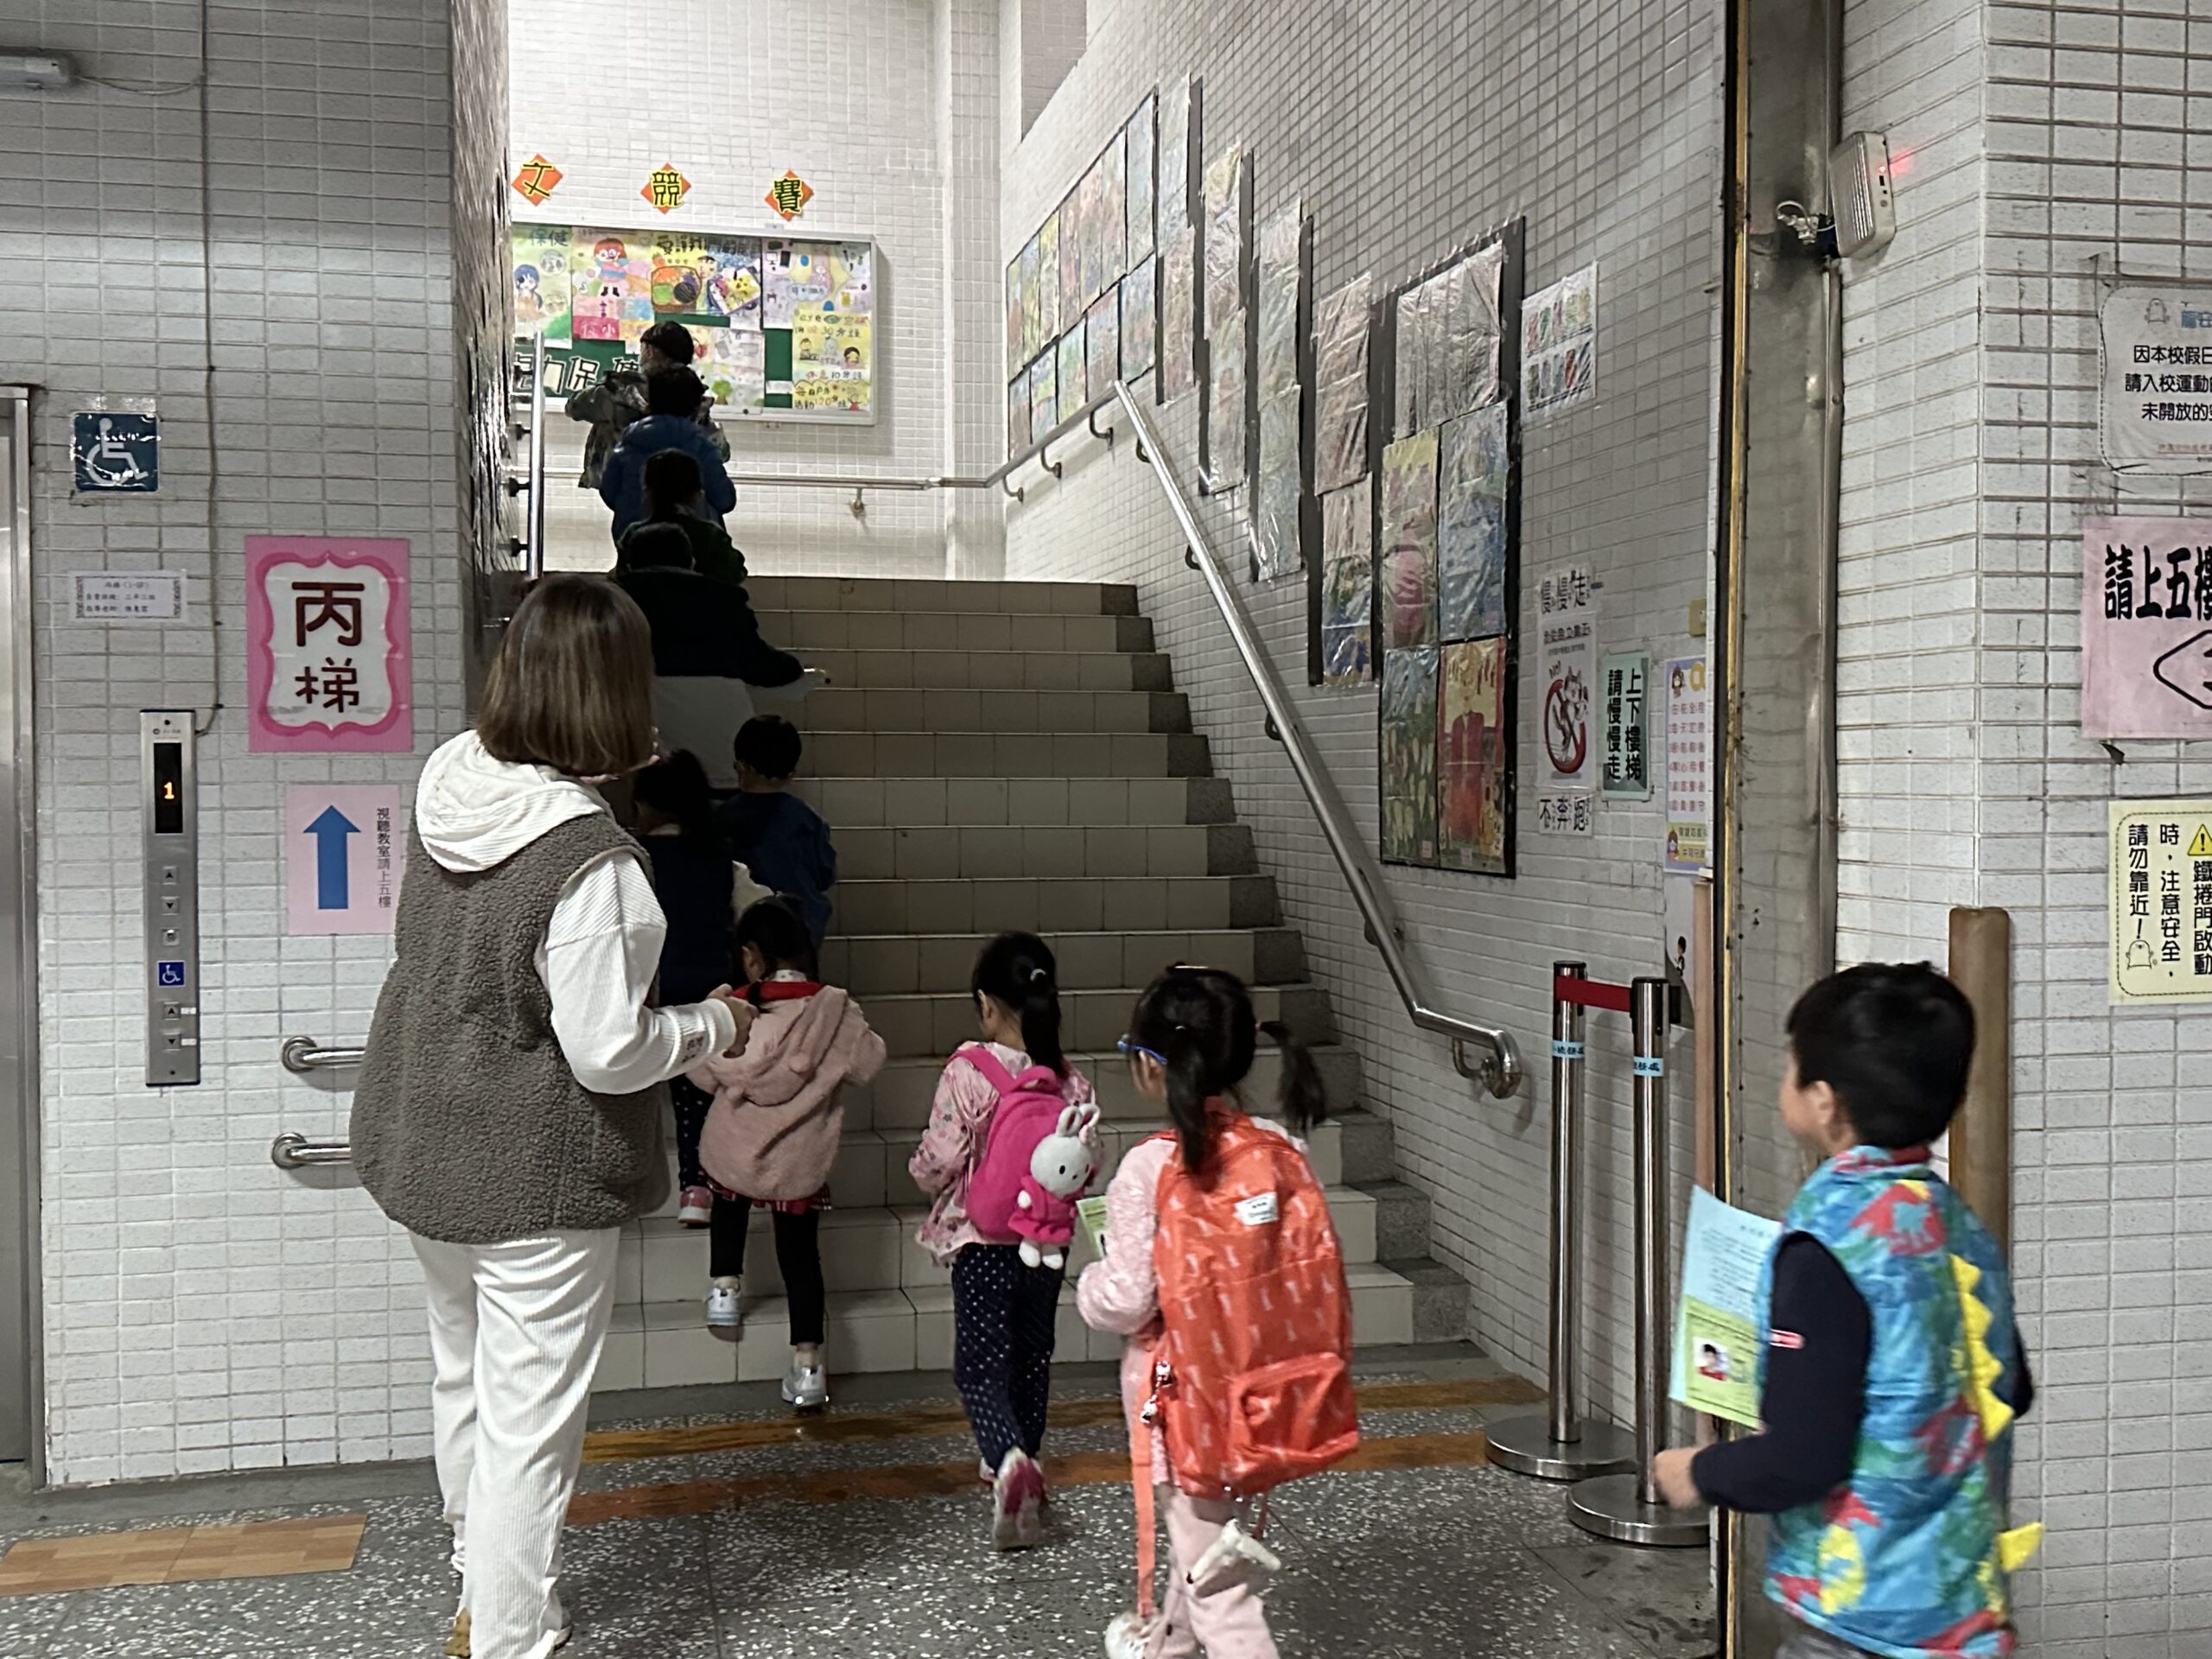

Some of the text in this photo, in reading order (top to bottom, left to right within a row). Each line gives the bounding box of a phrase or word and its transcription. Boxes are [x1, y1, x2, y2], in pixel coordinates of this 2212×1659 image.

[2125, 373, 2212, 392] 請入校運動
[2105, 543, 2212, 621] 請上五樓
[291, 582, 365, 714] 丙梯
[1607, 669, 1623, 780] 請慢慢走
[1625, 668, 1642, 780] 上下樓梯
[163, 781, 175, 800] 1
[377, 807, 391, 908] 視聽教室請上五樓
[2128, 823, 2150, 939] 請勿靠近！
